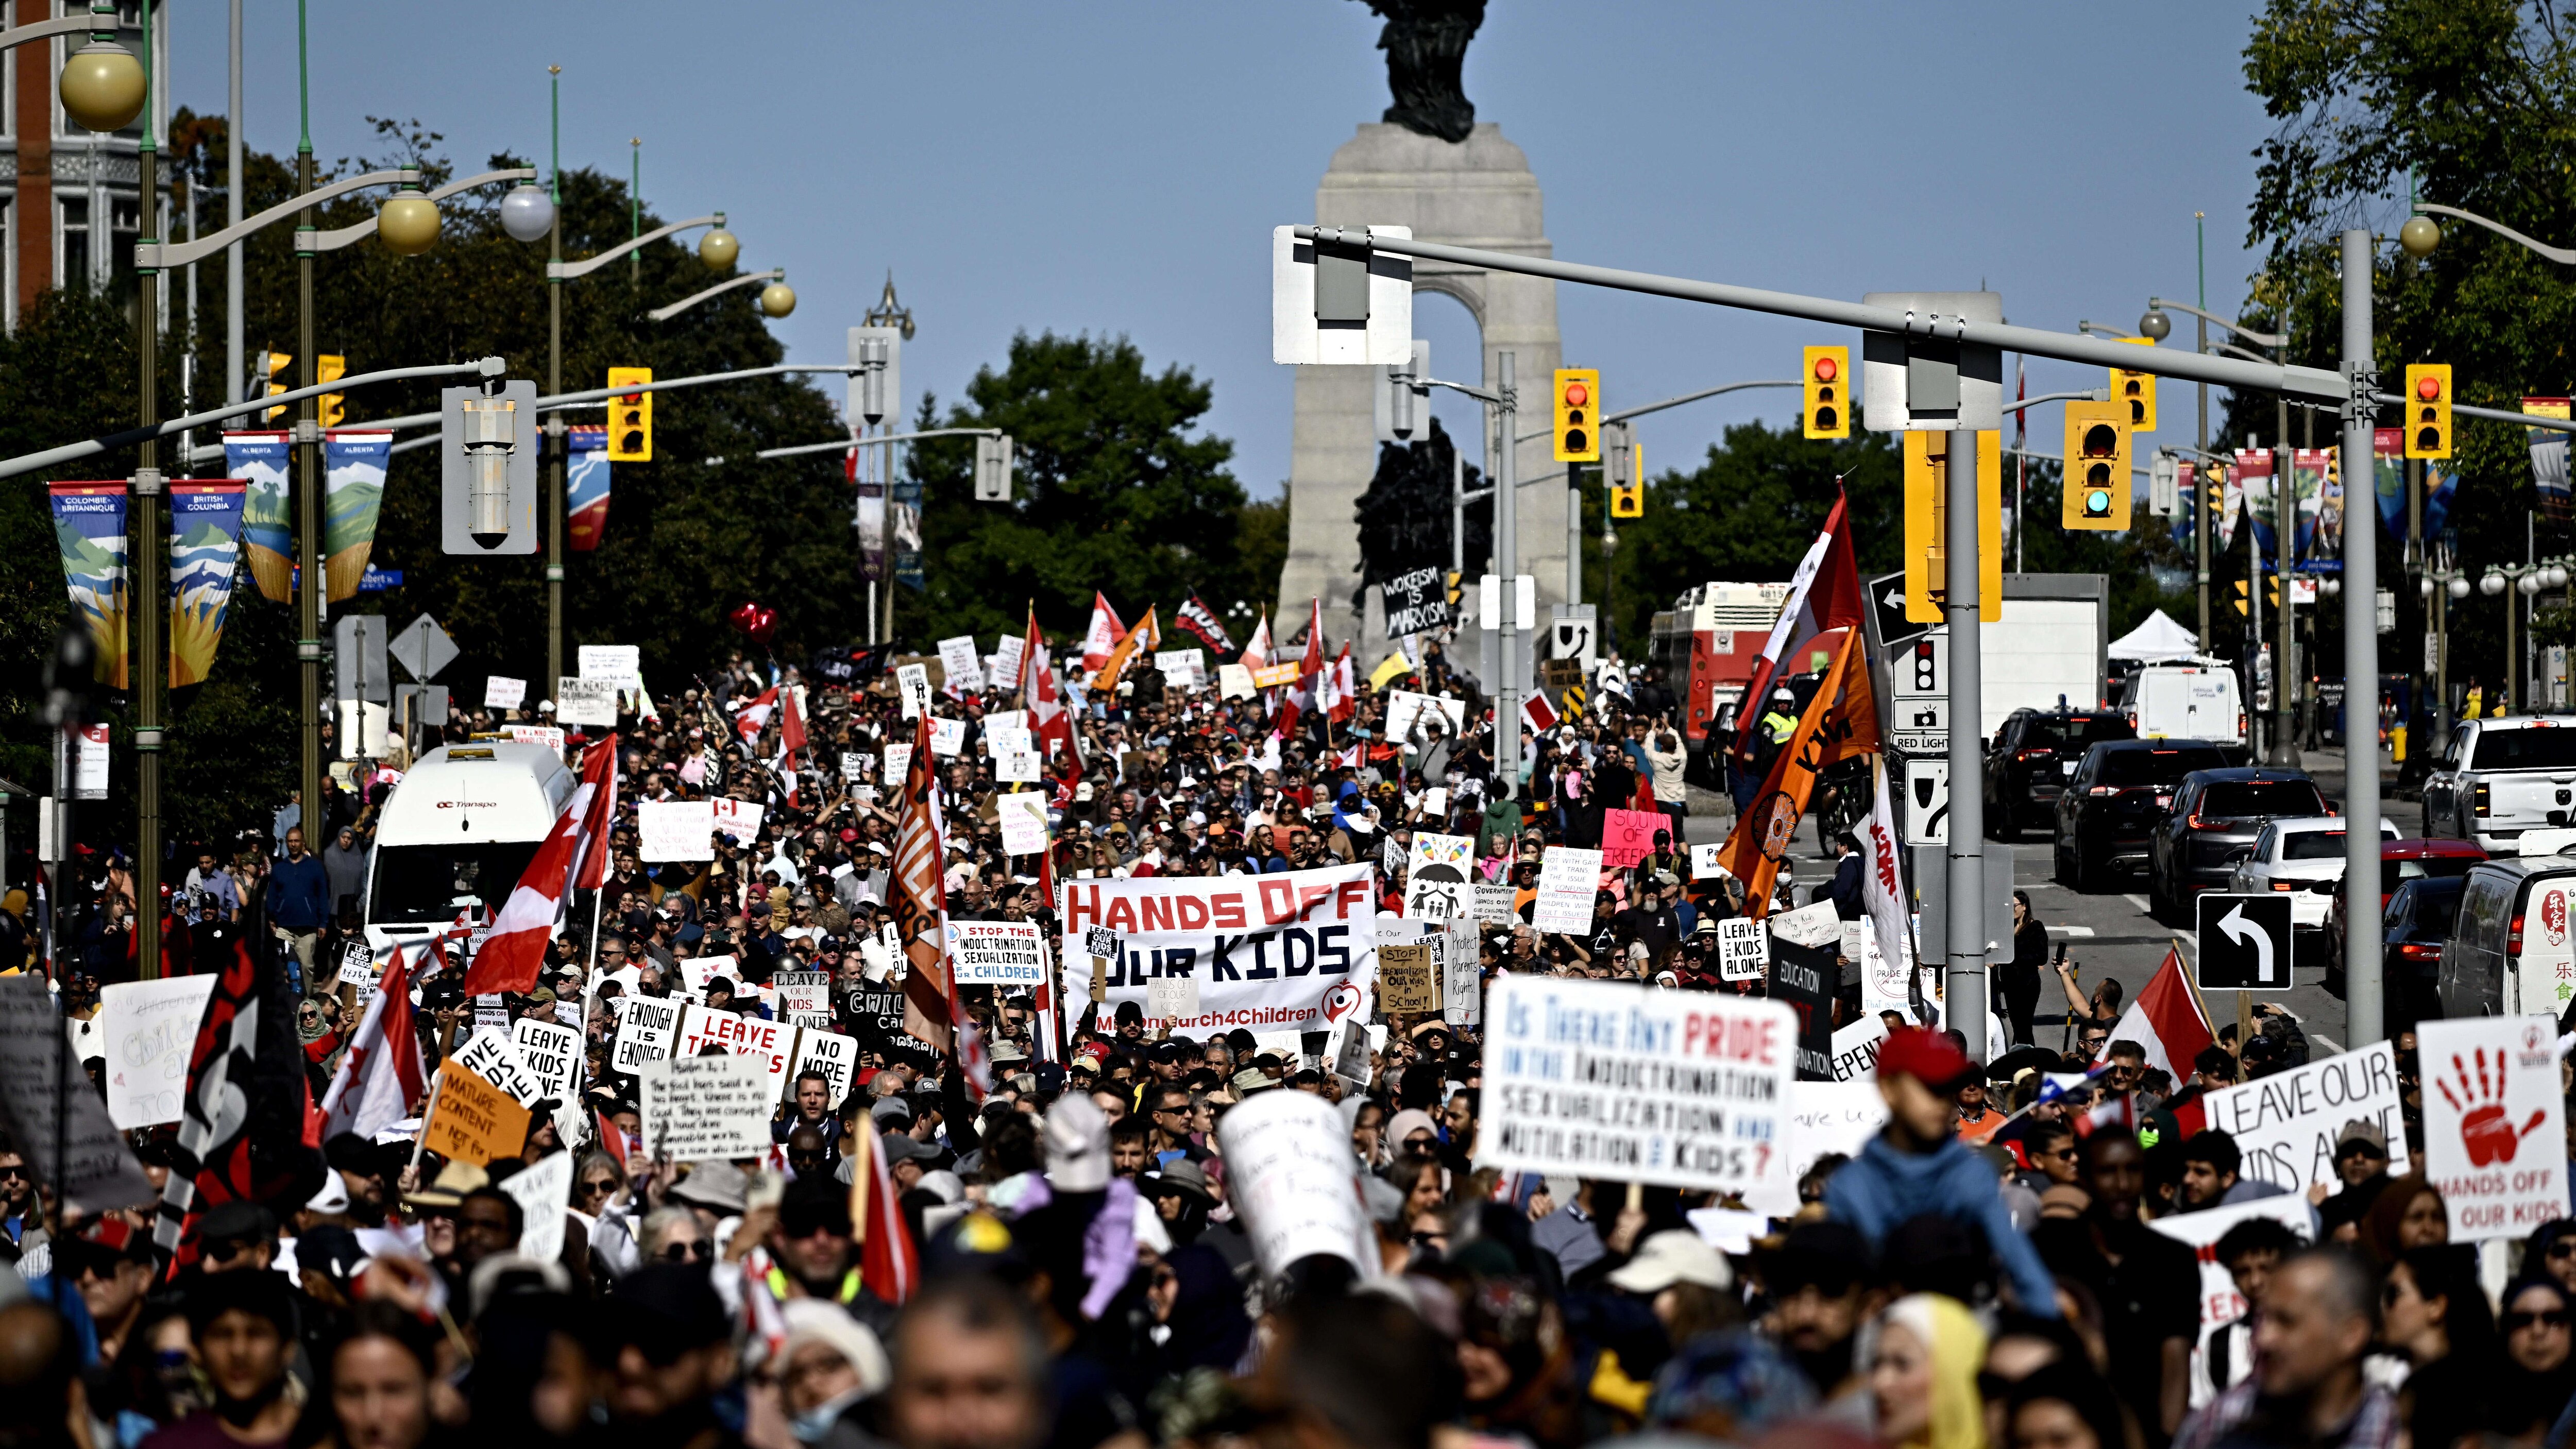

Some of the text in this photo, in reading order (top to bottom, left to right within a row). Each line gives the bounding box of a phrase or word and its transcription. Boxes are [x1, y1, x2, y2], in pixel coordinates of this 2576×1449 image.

[65, 497, 111, 505] COLOMBIE-
[194, 495, 223, 503] BRITISH
[62, 504, 115, 512] BRITANNIQUE
[188, 503, 229, 512] COLUMBIA
[1382, 566, 1439, 596] WOKEISM
[1407, 588, 1423, 607] IS
[1387, 600, 1448, 637] MARXISM
[1897, 738, 1918, 748] RED
[456, 800, 497, 809] Transpo
[719, 817, 757, 830] CANADA HAS
[1614, 809, 1668, 830] SOUND
[1017, 830, 1034, 839] FOR
[1623, 828, 1644, 843] OF
[1010, 839, 1043, 849] MINORS
[1475, 887, 1516, 895] GOVERNMENT
[1538, 892, 1593, 901] IMPRESSIONABLE
[1067, 884, 1248, 934] HANDS
[1258, 878, 1369, 926] OFF
[1784, 913, 1815, 931] My Kids
[969, 927, 1036, 937] STOP THE
[1089, 925, 1117, 939] LEAVE
[1724, 923, 1760, 939] LEAVE
[1791, 931, 1803, 941] not
[1806, 924, 1822, 937] yours
[959, 937, 1037, 951] INDOCTRINATION
[1091, 941, 1113, 951] KIDS
[1093, 934, 1113, 945] OUR
[1414, 933, 1443, 946] LEAVE
[1452, 930, 1478, 951] Protect
[355, 945, 369, 954] LET
[1087, 946, 1116, 960] ALONE
[1212, 925, 1351, 983] KIDS
[1386, 947, 1423, 961] STOP!
[1735, 939, 1762, 957] KIDS
[345, 957, 371, 968] BE KIDS
[349, 951, 370, 962] KIDS
[964, 951, 1039, 965] SEXUALIZATION
[975, 965, 1040, 980] CHILDREN
[1452, 958, 1478, 977] Parents
[1726, 957, 1764, 975] ALONE
[2555, 962, 2571, 979] 乐
[775, 973, 828, 986] LEAVE
[1387, 975, 1408, 986] OUR
[1780, 959, 1820, 994] EDUCATION
[1877, 969, 1901, 978] PRIDE
[1150, 978, 1193, 990] HANDS OFF
[1404, 985, 1412, 995] in
[2554, 981, 2573, 1001] 食
[790, 987, 812, 996] OUR
[1158, 990, 1187, 1000] OF OUR
[1452, 979, 1476, 1005] Rights!
[1161, 1002, 1180, 1013] KIDS
[1865, 999, 1880, 1009] That
[1891, 999, 1908, 1009] YOUR
[628, 1001, 673, 1032] ENOUGH
[637, 1030, 656, 1042] IS
[704, 1015, 777, 1050] LEAVE
[1543, 993, 1778, 1066] THERE ANY PRIDE
[519, 1026, 571, 1054] LEAVE
[619, 1041, 666, 1068] ENOUGH
[815, 1038, 841, 1059] NO
[1083, 1046, 1100, 1056] Cuba
[528, 1049, 567, 1077] KIDS
[671, 1060, 703, 1074] Psalm
[802, 1060, 846, 1083] MORE
[1529, 1046, 1564, 1081] THE
[1571, 1047, 1778, 1102] INDOCTRINATION
[650, 1078, 666, 1092] The
[718, 1077, 741, 1089] said
[447, 1073, 498, 1117] MATURE
[737, 1091, 767, 1101] is no
[2213, 1051, 2393, 1136] LEAVE OUR
[438, 1094, 497, 1137] CONTENT
[705, 1107, 721, 1117] are
[1500, 1082, 1726, 1136] SEXUALIZATION
[673, 1119, 721, 1130] have done
[447, 1124, 471, 1146] NOT
[470, 1139, 484, 1157] for
[713, 1145, 728, 1154] who
[1498, 1119, 1746, 1178] MUTILATION KIDS
[2435, 1169, 2552, 1198] HANDS OFF
[2460, 1200, 2562, 1229] OUR KIDS
